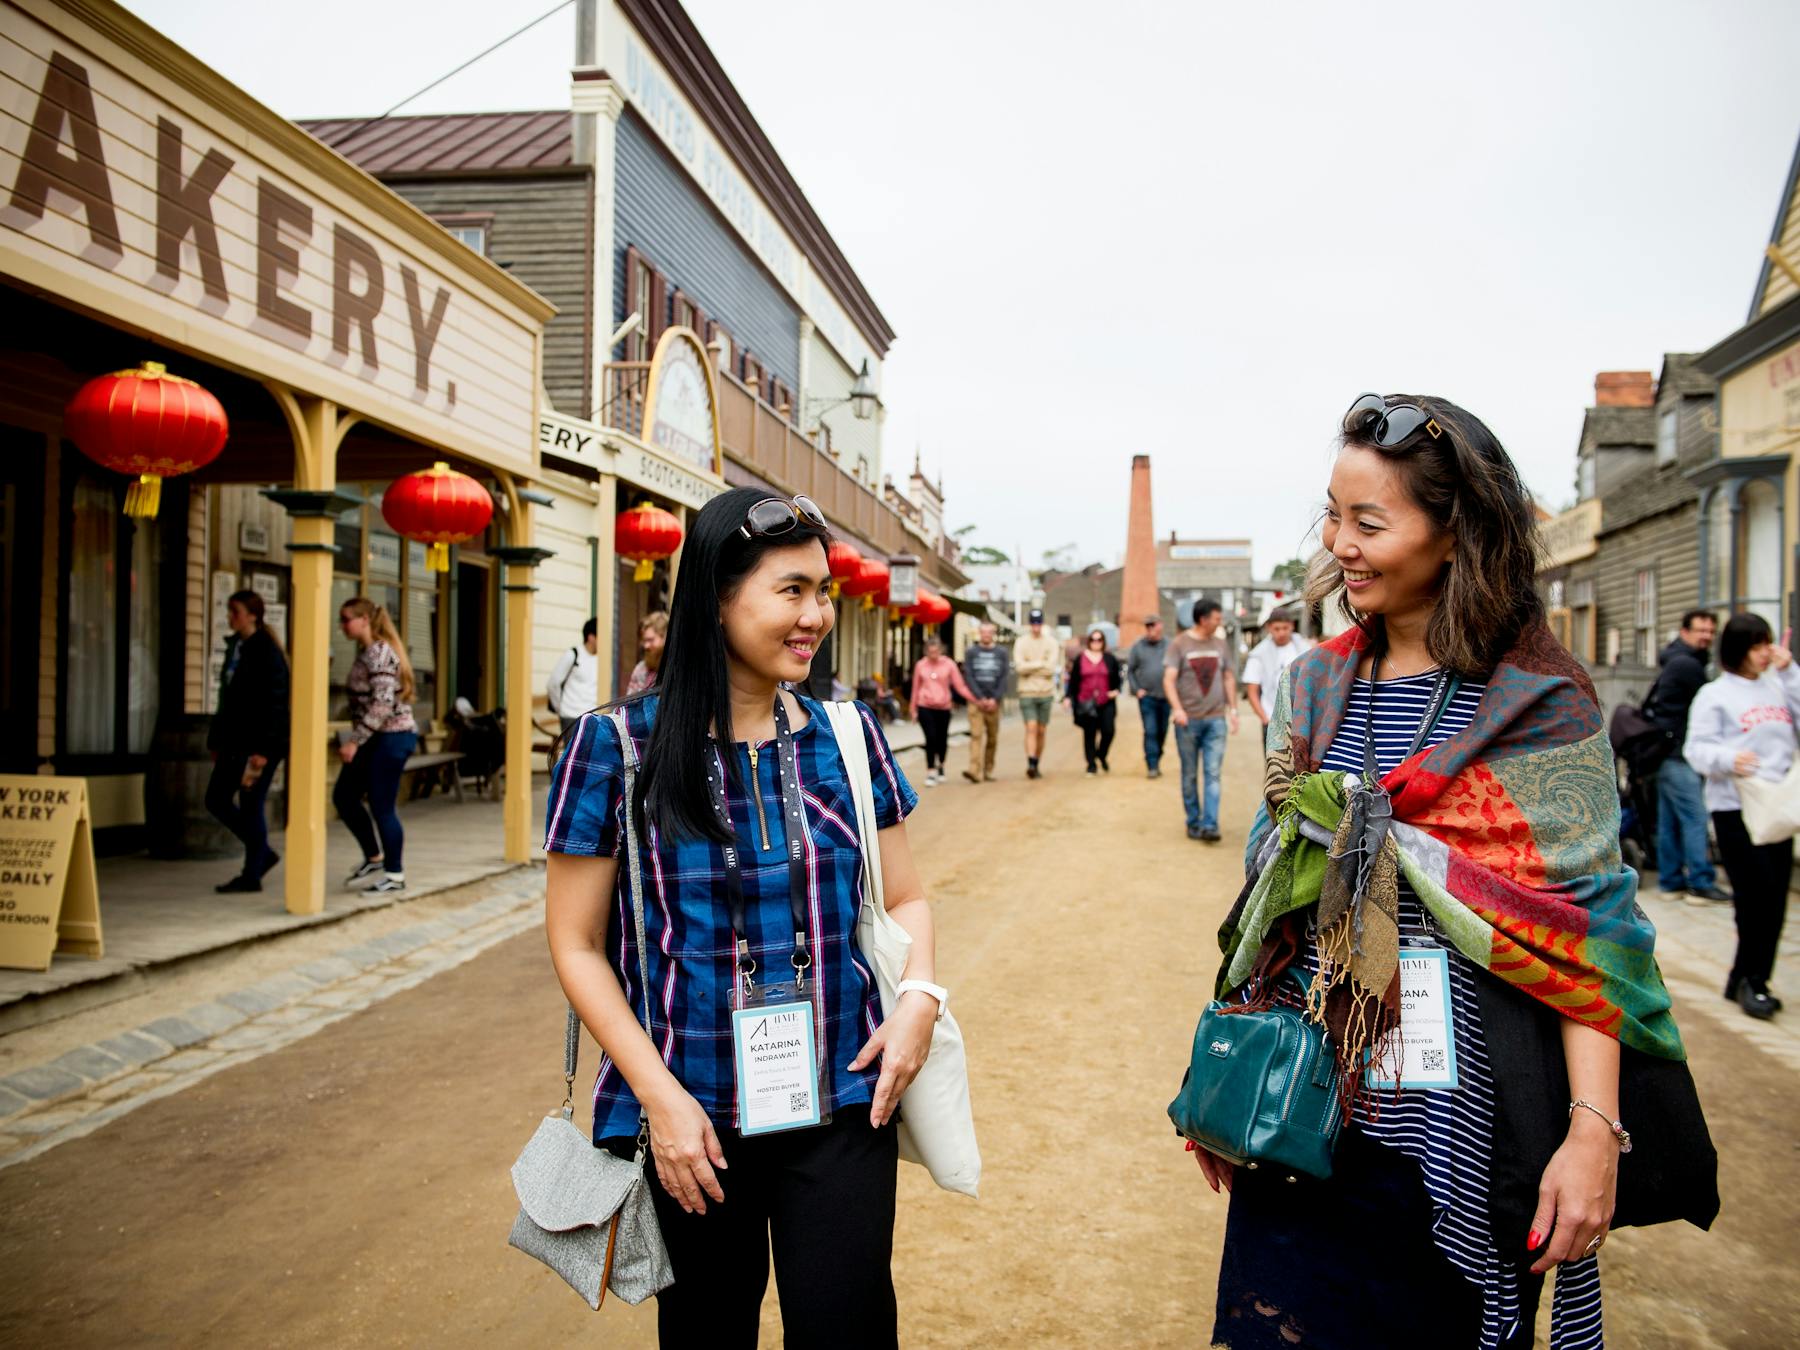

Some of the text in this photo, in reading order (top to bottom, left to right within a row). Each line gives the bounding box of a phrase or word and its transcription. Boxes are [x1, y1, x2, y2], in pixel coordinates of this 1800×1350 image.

[18, 787, 71, 805] YORK
[2, 804, 57, 822] KERY
[15, 838, 57, 848] COFFEE
[2, 871, 54, 886] DAILY
[750, 1039, 801, 1053] KATARINA
[754, 1051, 799, 1063] INDRAWATI
